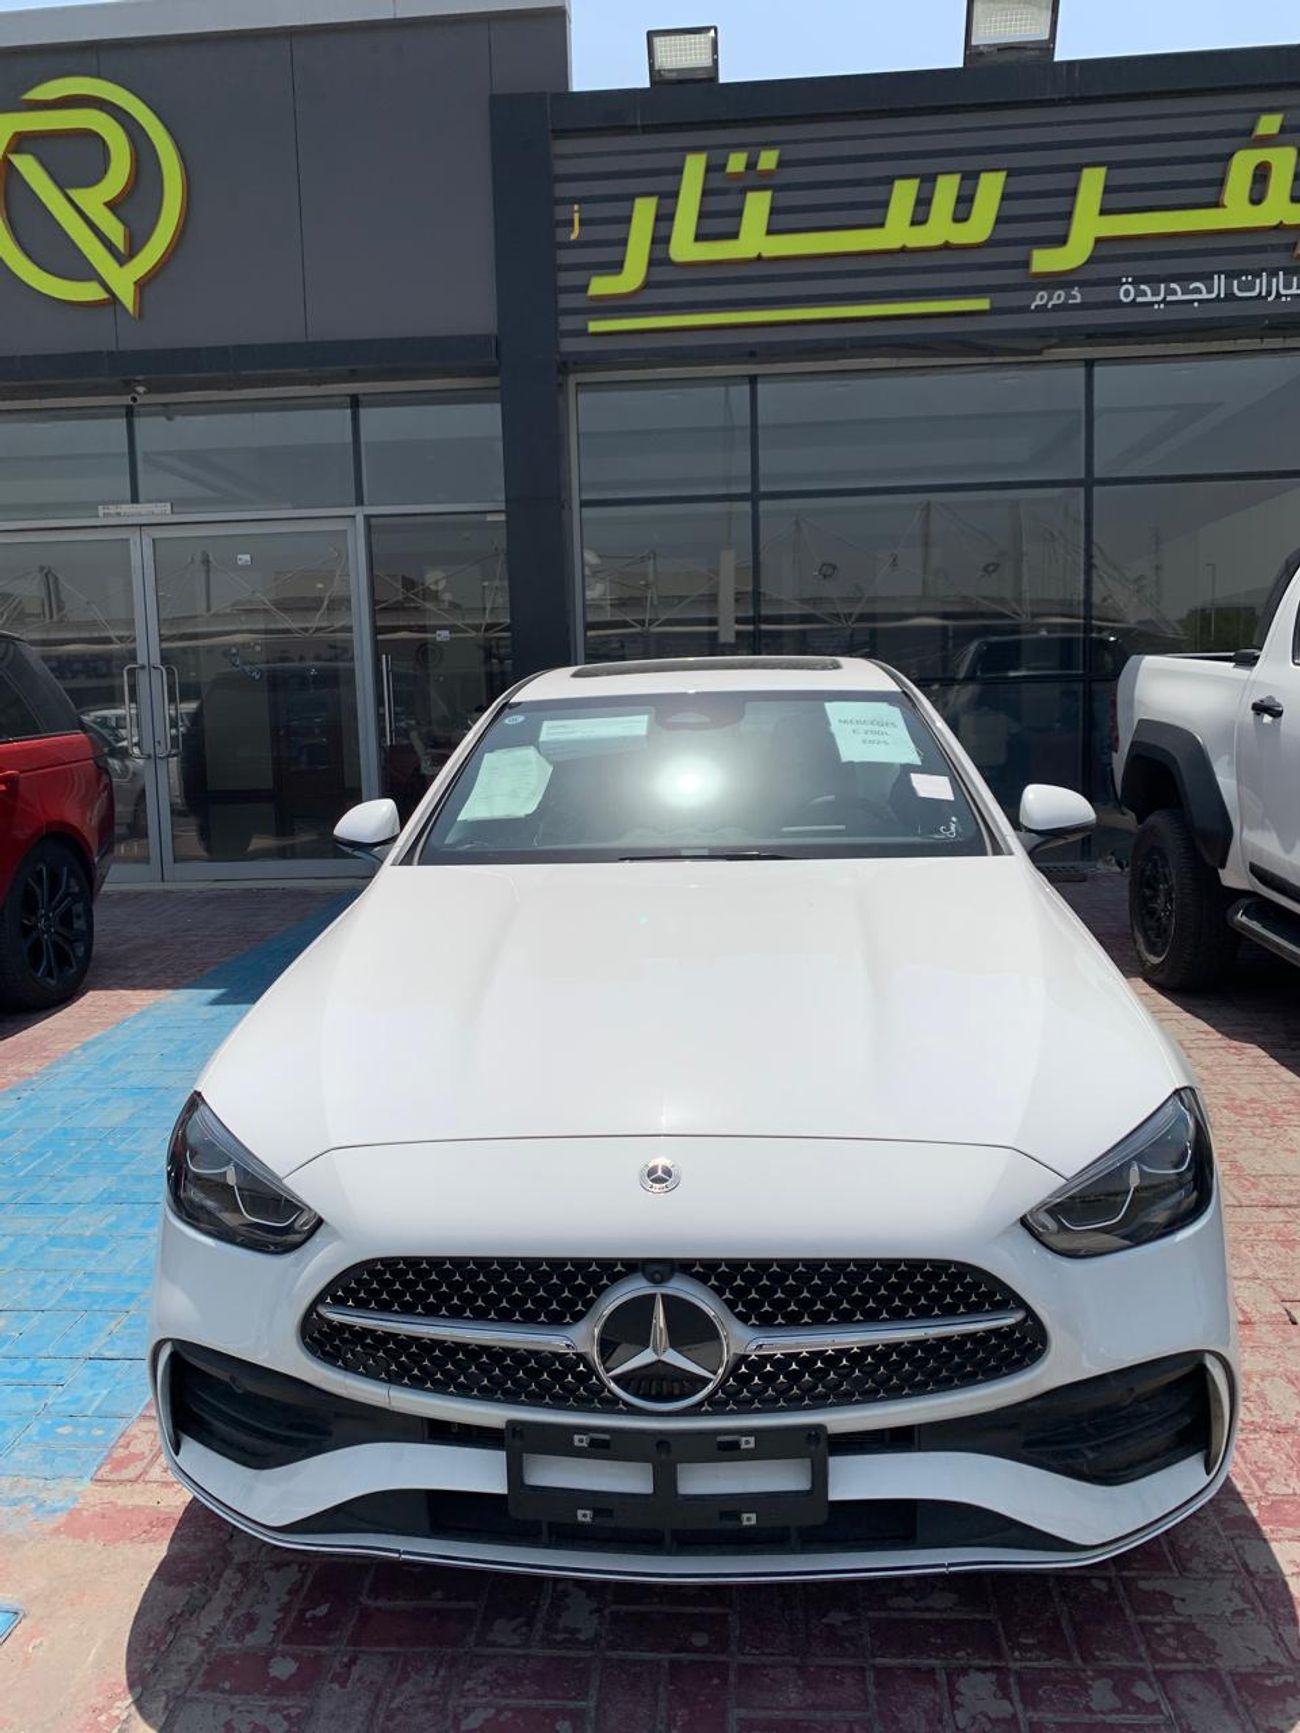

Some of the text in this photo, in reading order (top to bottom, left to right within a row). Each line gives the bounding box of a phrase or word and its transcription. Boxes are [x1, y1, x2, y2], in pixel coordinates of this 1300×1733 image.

[587, 113, 1300, 297] فر ستار
[1119, 275, 1226, 309] الجديدة
[1233, 271, 1300, 302] يارات
